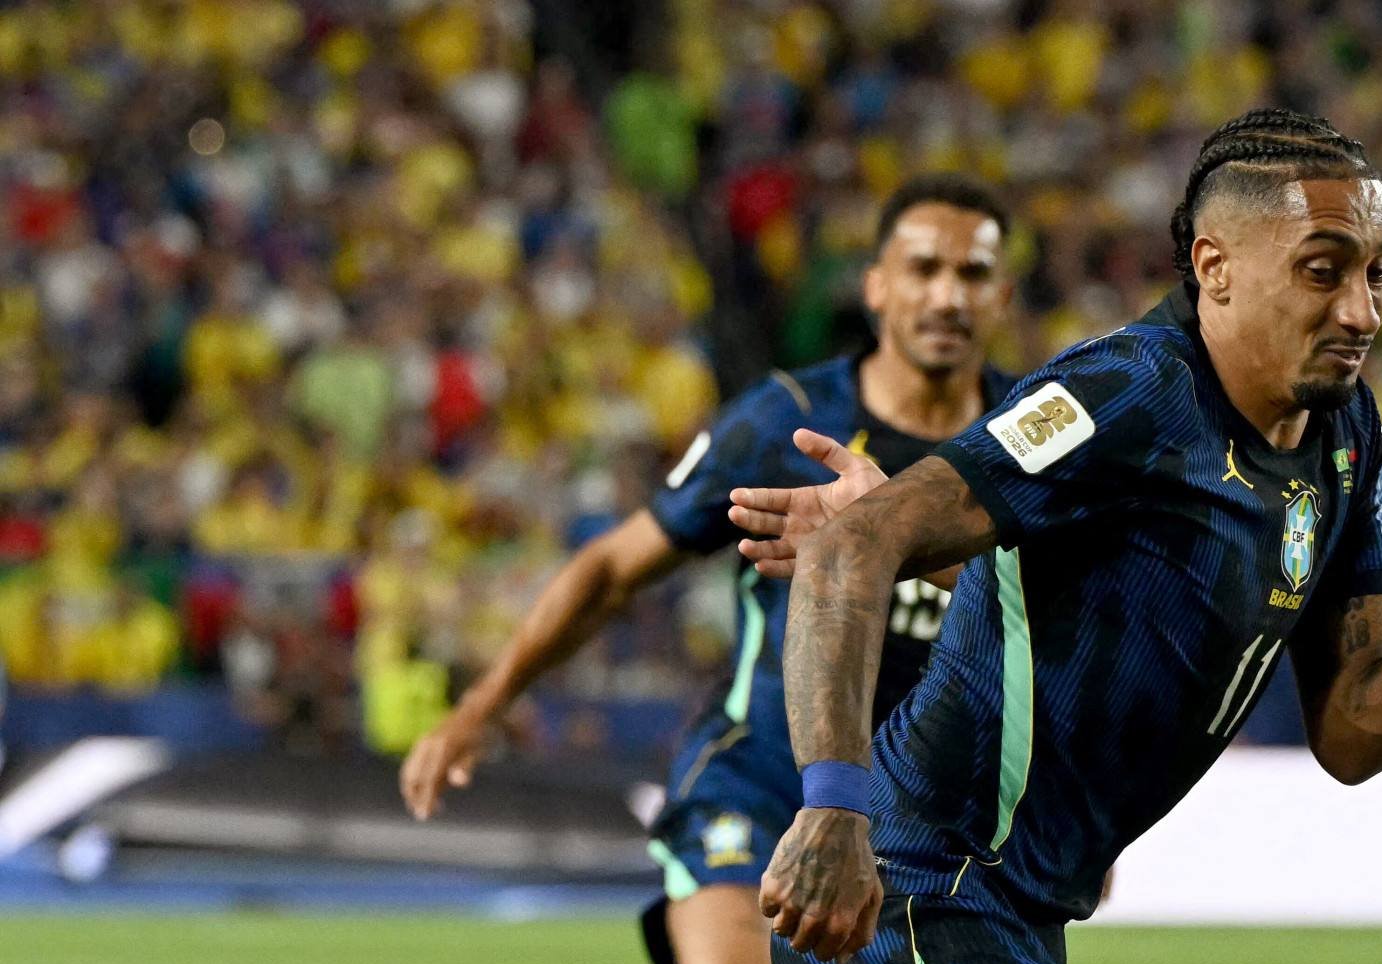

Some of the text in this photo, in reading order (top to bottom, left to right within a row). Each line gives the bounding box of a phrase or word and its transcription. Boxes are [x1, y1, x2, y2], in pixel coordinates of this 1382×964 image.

[1000, 429, 1027, 457] 2026
[1292, 531, 1305, 543] CBF
[1207, 634, 1282, 738] 11
